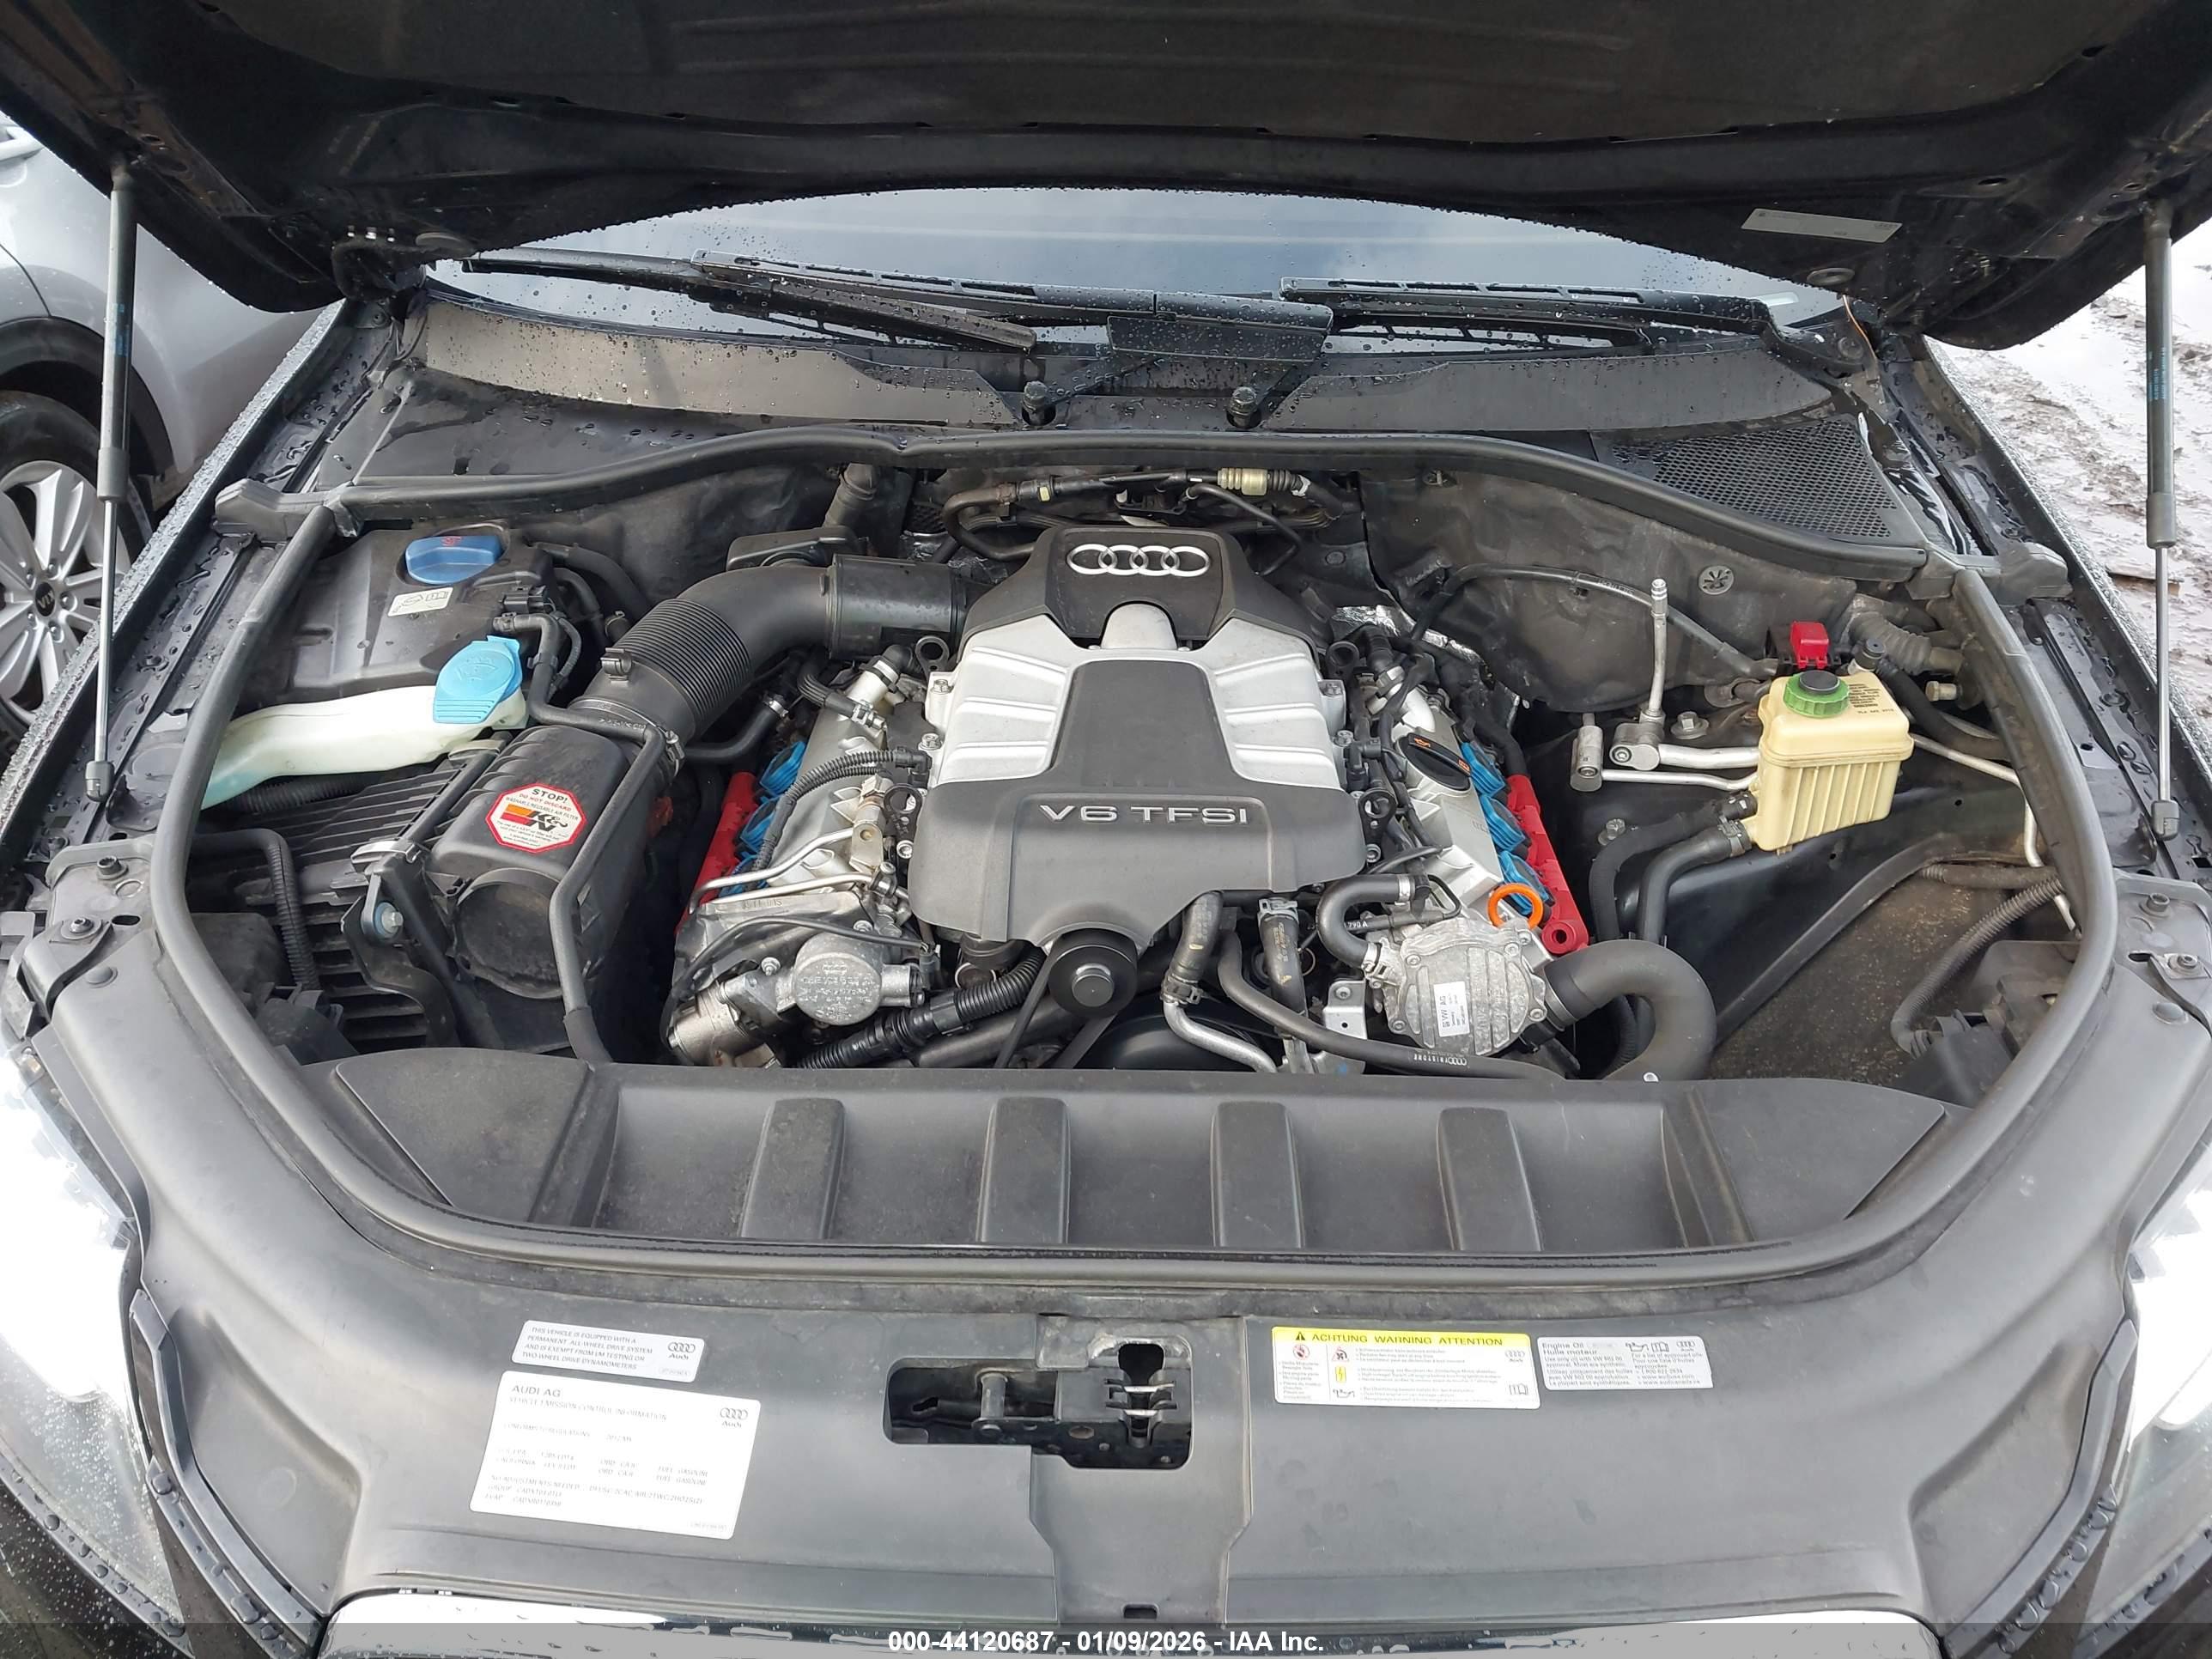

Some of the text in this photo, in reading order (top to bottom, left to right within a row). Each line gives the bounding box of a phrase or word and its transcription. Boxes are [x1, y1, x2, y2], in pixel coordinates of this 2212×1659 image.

[37, 591, 54, 609] KIA
[532, 788, 568, 803] STOP!
[544, 800, 571, 811] DISCARD
[1039, 805, 1248, 825] V6 TFSI
[526, 1335, 567, 1344] PERMANENT
[1312, 1334, 1503, 1346] ACHTUNG WARNING ATTENTION
[1542, 1342, 1571, 1351] Engine
[581, 1358, 636, 1369] DYNAMOMETERS
[512, 1384, 561, 1397] AUDI AG
